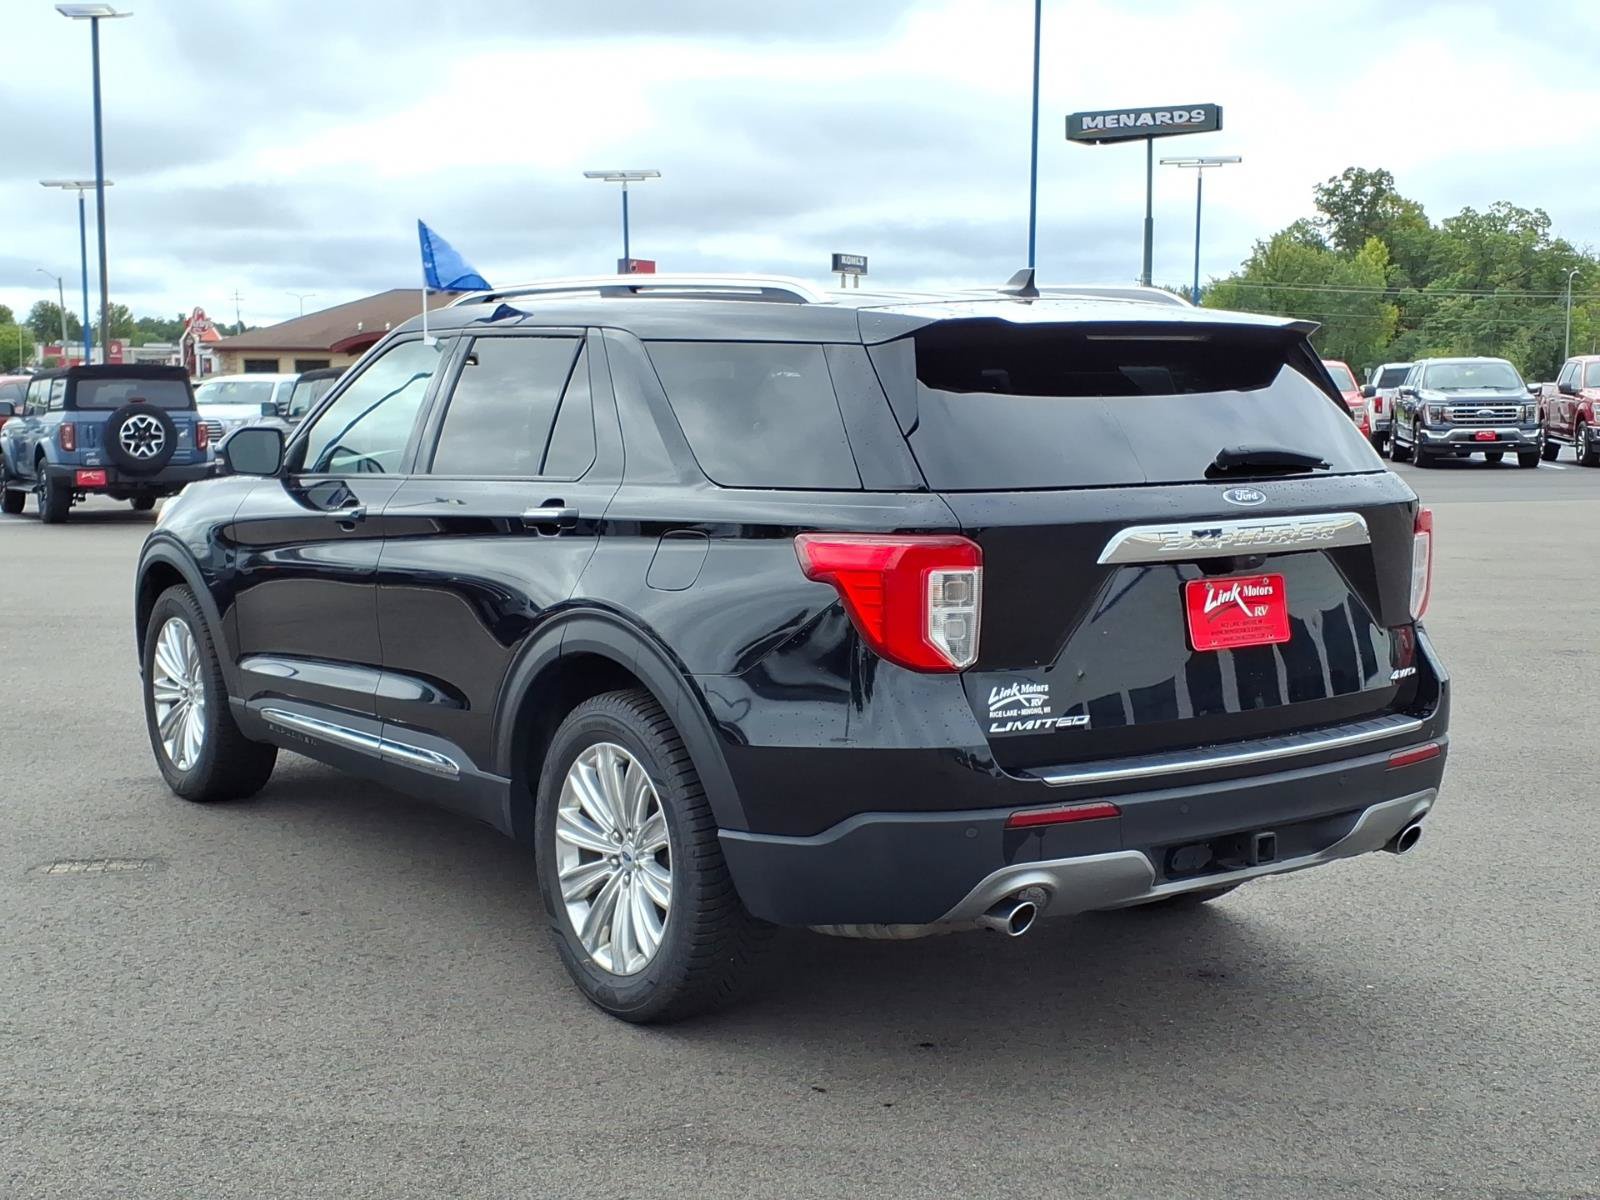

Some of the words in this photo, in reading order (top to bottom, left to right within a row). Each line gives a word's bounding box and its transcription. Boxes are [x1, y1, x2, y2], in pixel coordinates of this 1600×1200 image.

[1082, 109, 1206, 129] MENARDS
[1158, 526, 1336, 551] EXPLORER
[1203, 583, 1253, 617] Link
[1243, 585, 1273, 597] Motors
[1254, 605, 1270, 617] RV
[1390, 667, 1416, 680] 4WD
[988, 682, 1029, 706] Link
[1021, 683, 1049, 694] Motors
[989, 710, 1002, 718] RICE
[1003, 708, 1018, 717] LAKE
[989, 715, 1090, 732] LIMITED
